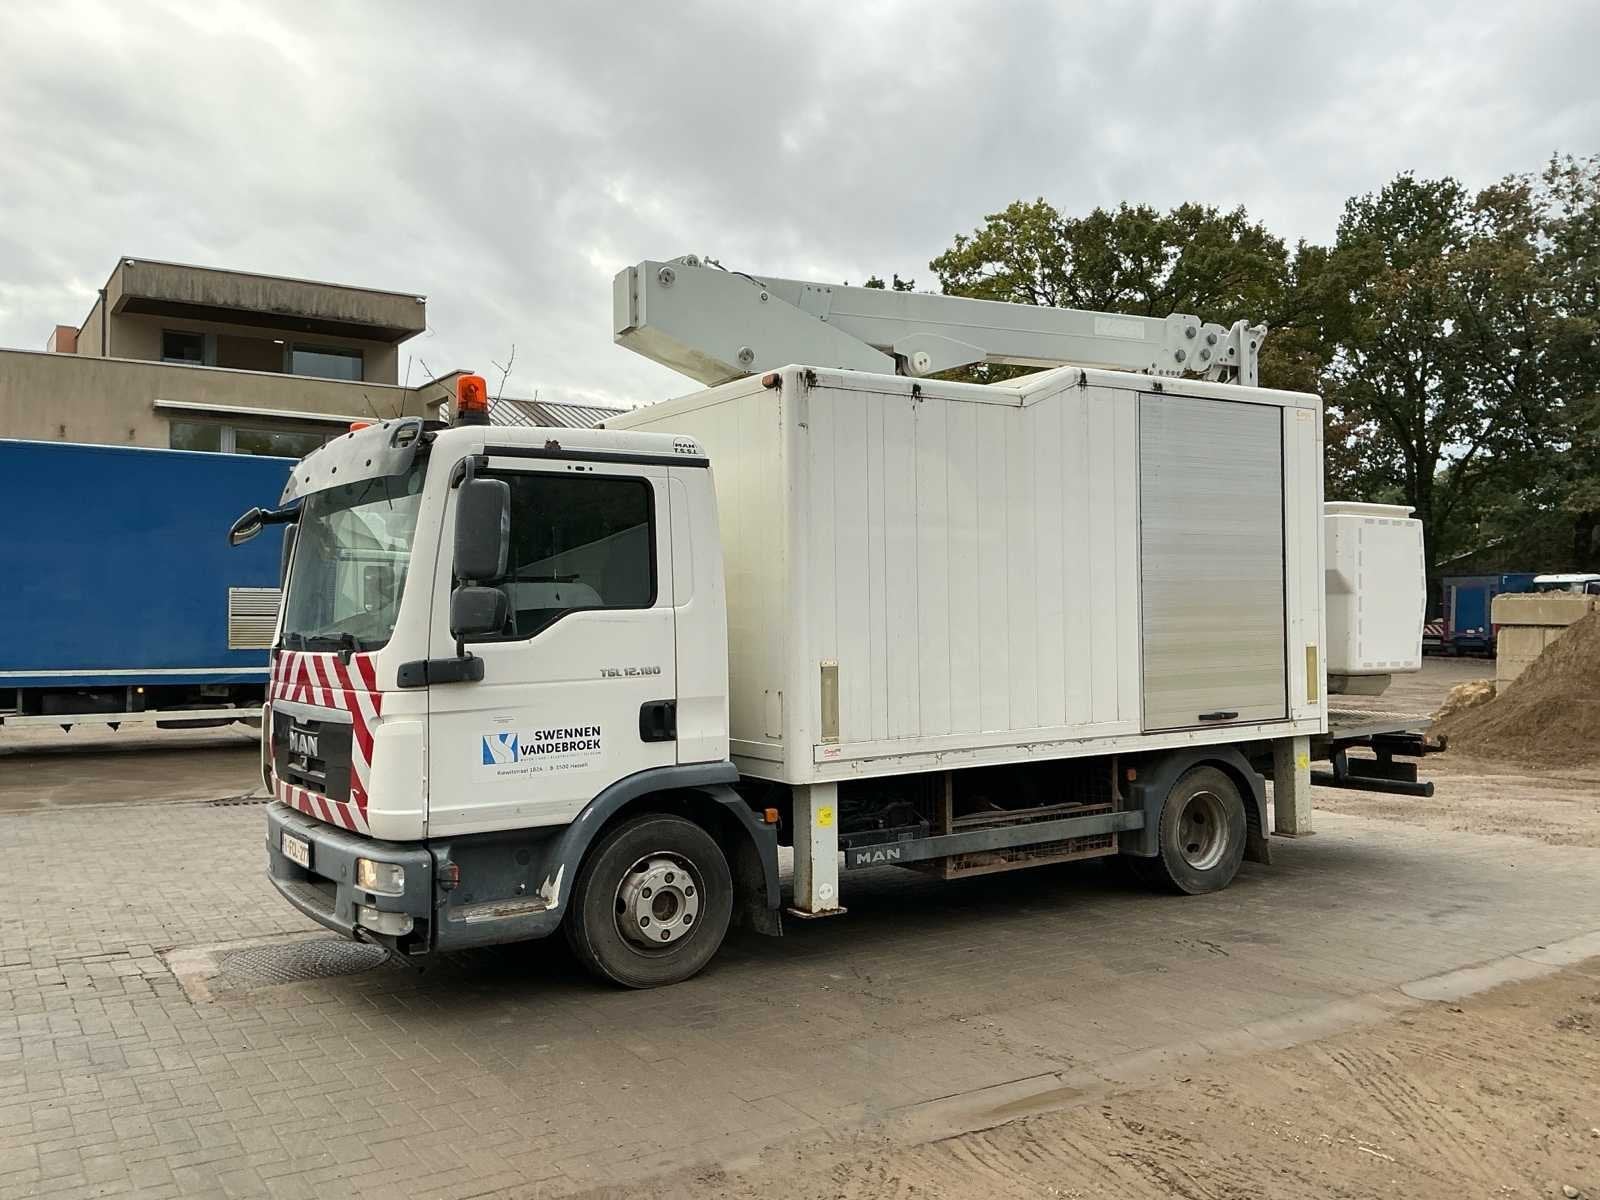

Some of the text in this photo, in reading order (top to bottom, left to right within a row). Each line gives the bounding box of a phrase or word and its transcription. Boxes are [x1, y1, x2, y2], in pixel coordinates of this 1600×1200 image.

[600, 668, 622, 677] TGL
[535, 726, 600, 740] SWENNEN
[289, 731, 319, 757] MAN
[520, 739, 600, 755] VANDEBROEK
[856, 848, 900, 864] MAN
